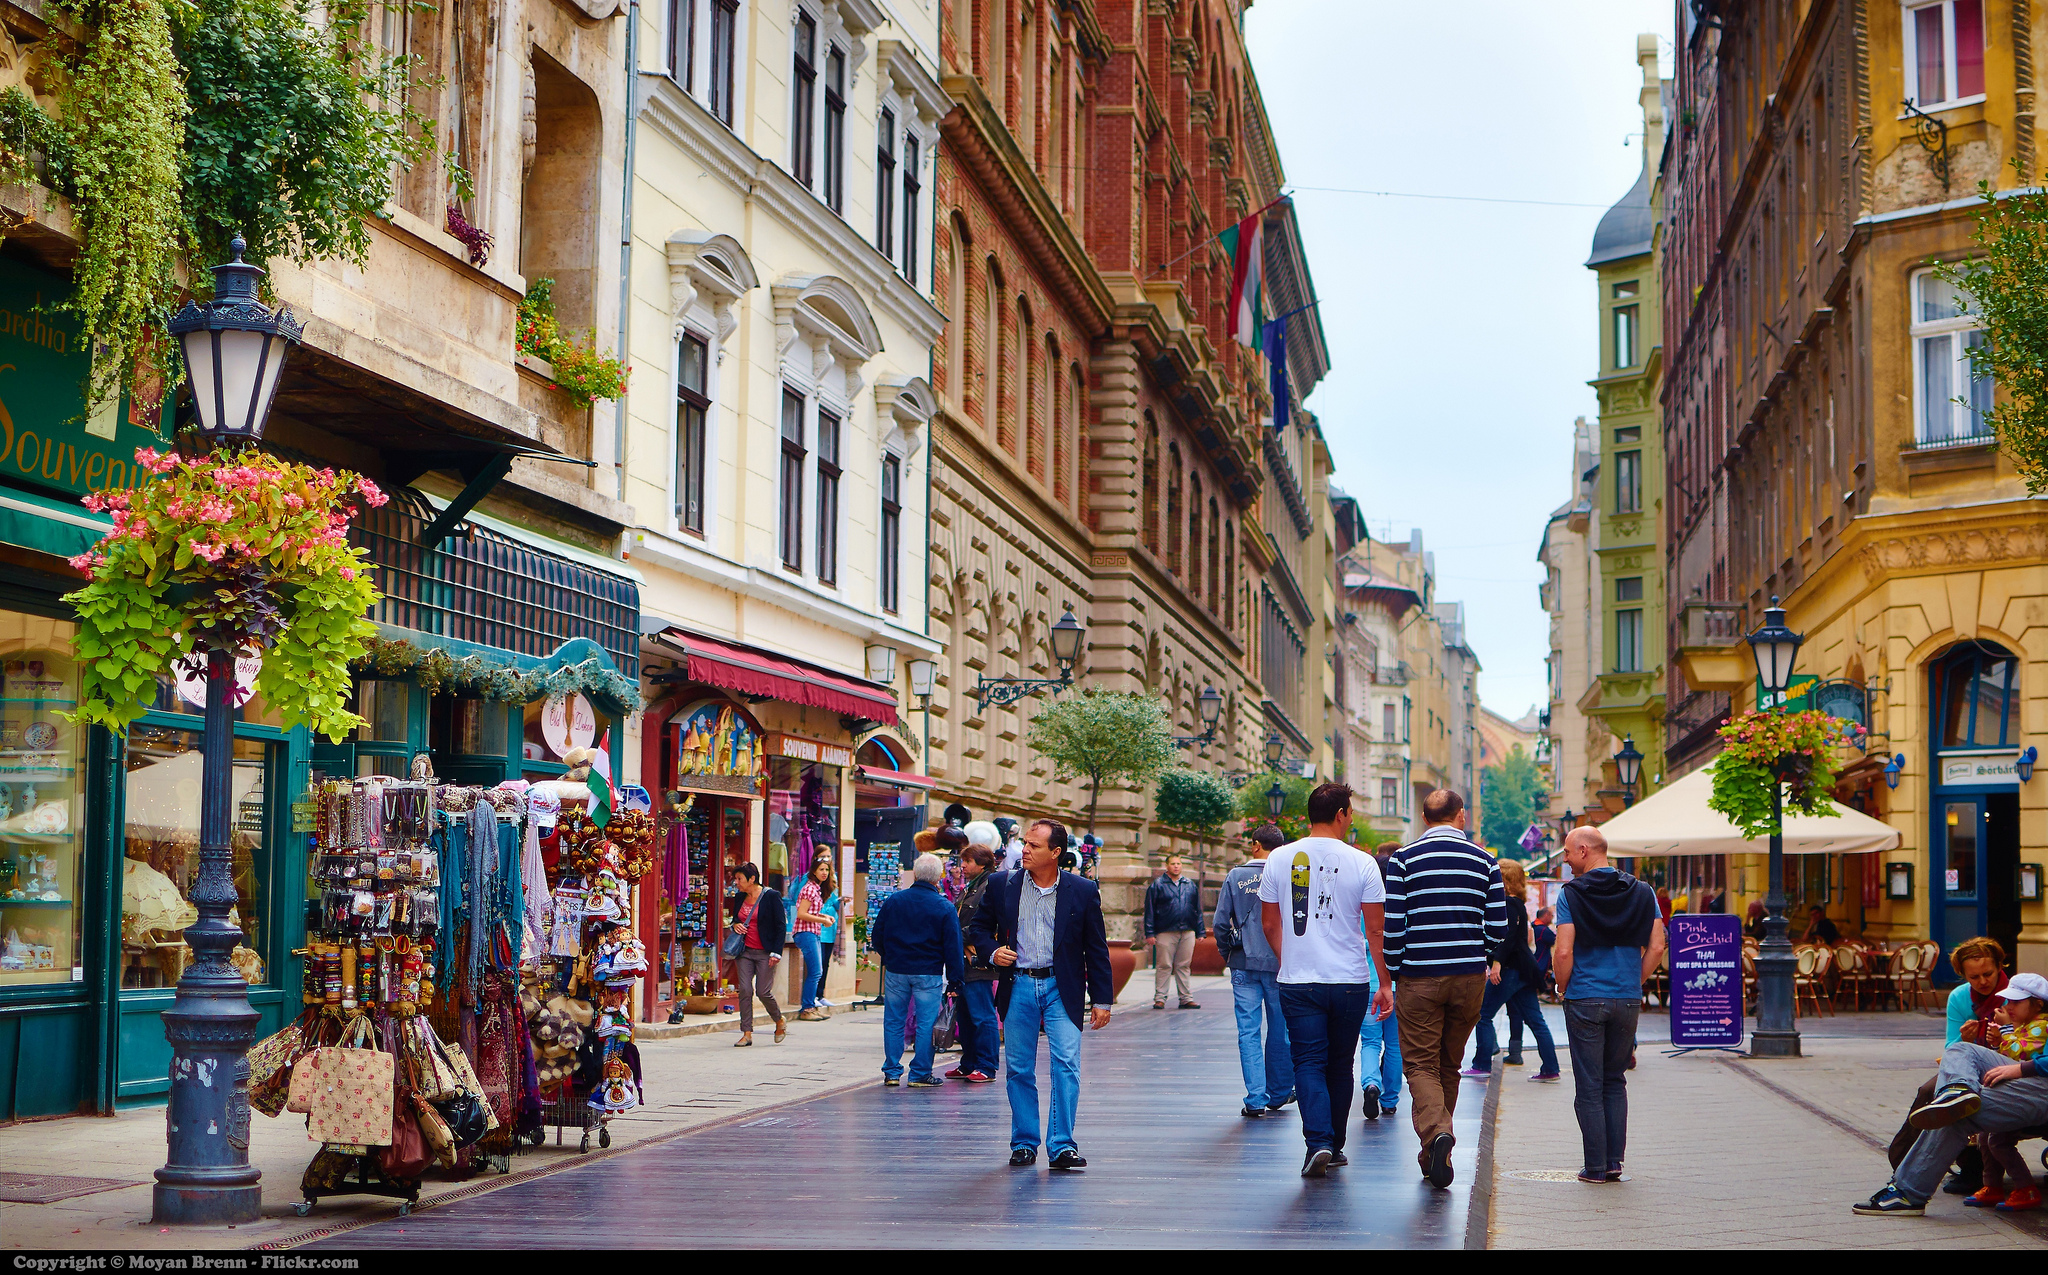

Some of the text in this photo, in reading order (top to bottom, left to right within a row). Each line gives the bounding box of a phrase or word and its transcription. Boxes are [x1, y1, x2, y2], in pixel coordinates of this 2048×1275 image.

[235, 659, 259, 675] ekor
[783, 738, 851, 767] SOUVENIR AJÁNDÉK
[1678, 922, 1708, 933] Pink
[1686, 932, 1733, 944] Orchid
[1696, 951, 1715, 960] THAI
[1708, 961, 1736, 969] MASSAGE
